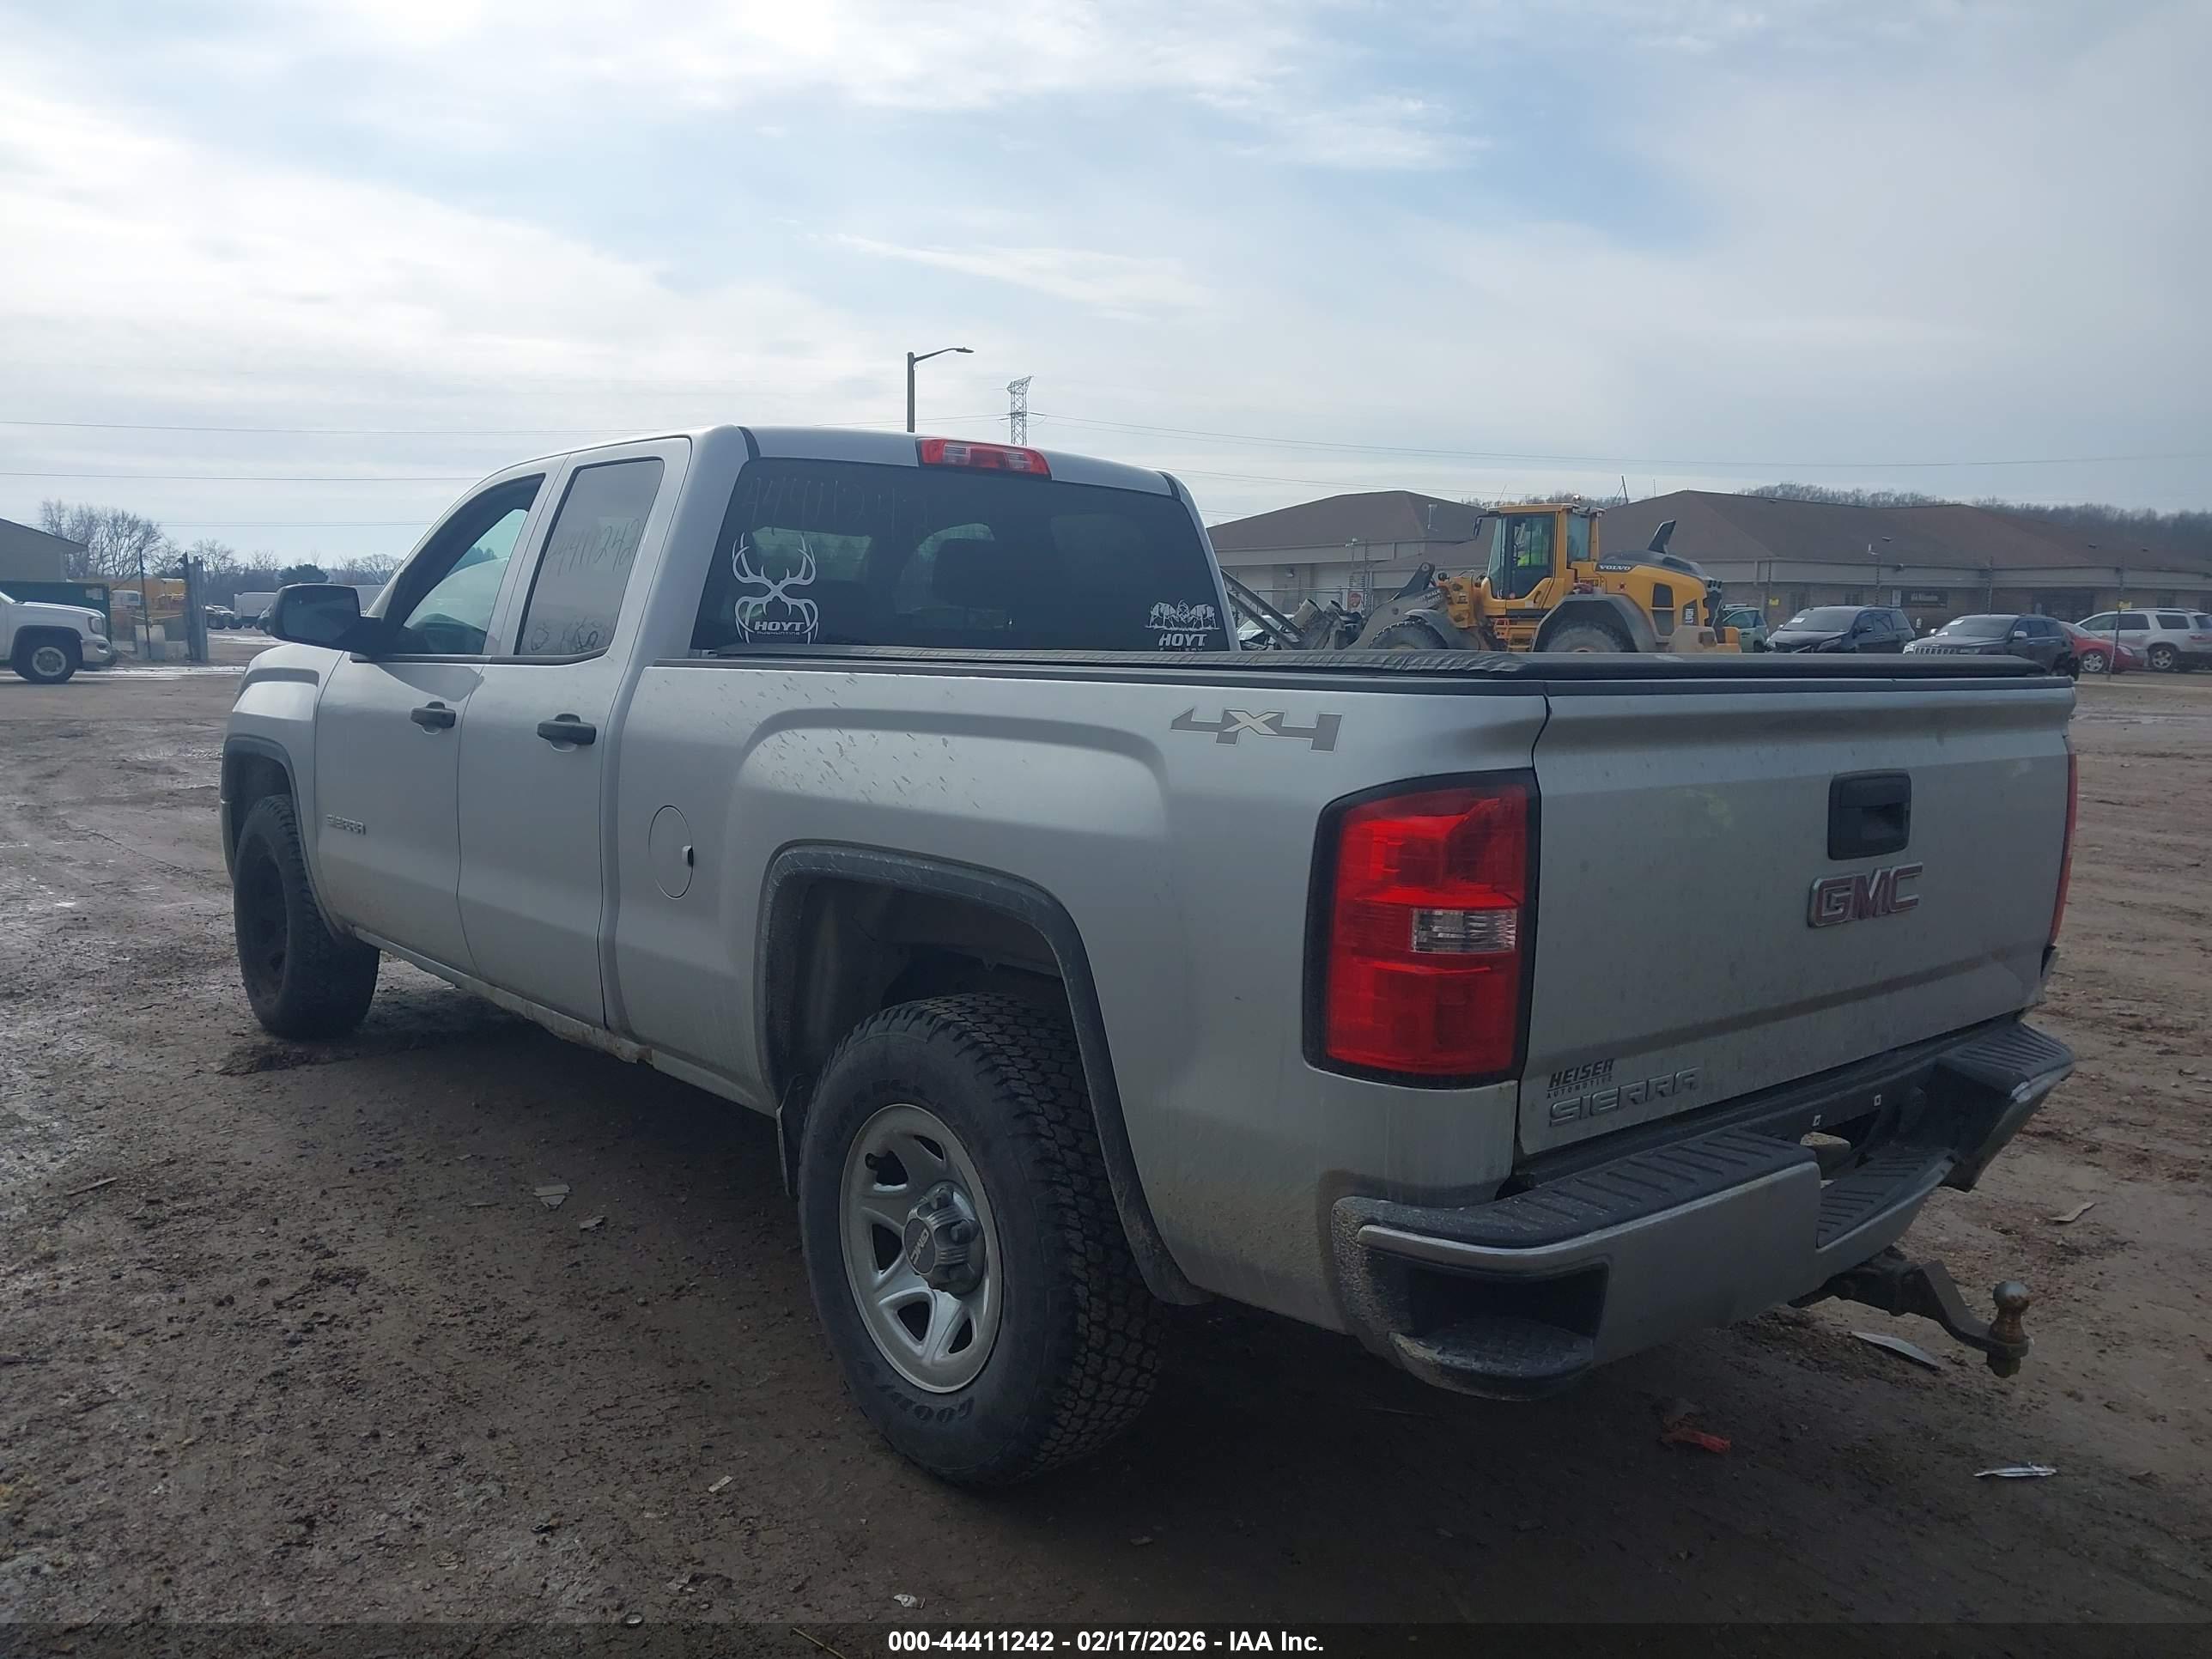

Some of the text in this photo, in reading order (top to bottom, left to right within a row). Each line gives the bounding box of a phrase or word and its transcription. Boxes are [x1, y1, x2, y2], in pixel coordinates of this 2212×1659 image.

[754, 621, 805, 631] HOYT
[1158, 633, 1208, 647] HOYT
[325, 814, 366, 836] SIERRA
[1808, 861, 1923, 928] GMC
[1547, 1075, 1613, 1099] AUTOMOTIVE
[1548, 1057, 1615, 1089] HEISER
[1549, 1067, 1701, 1127] SIERRA
[910, 1228, 929, 1265] GMC
